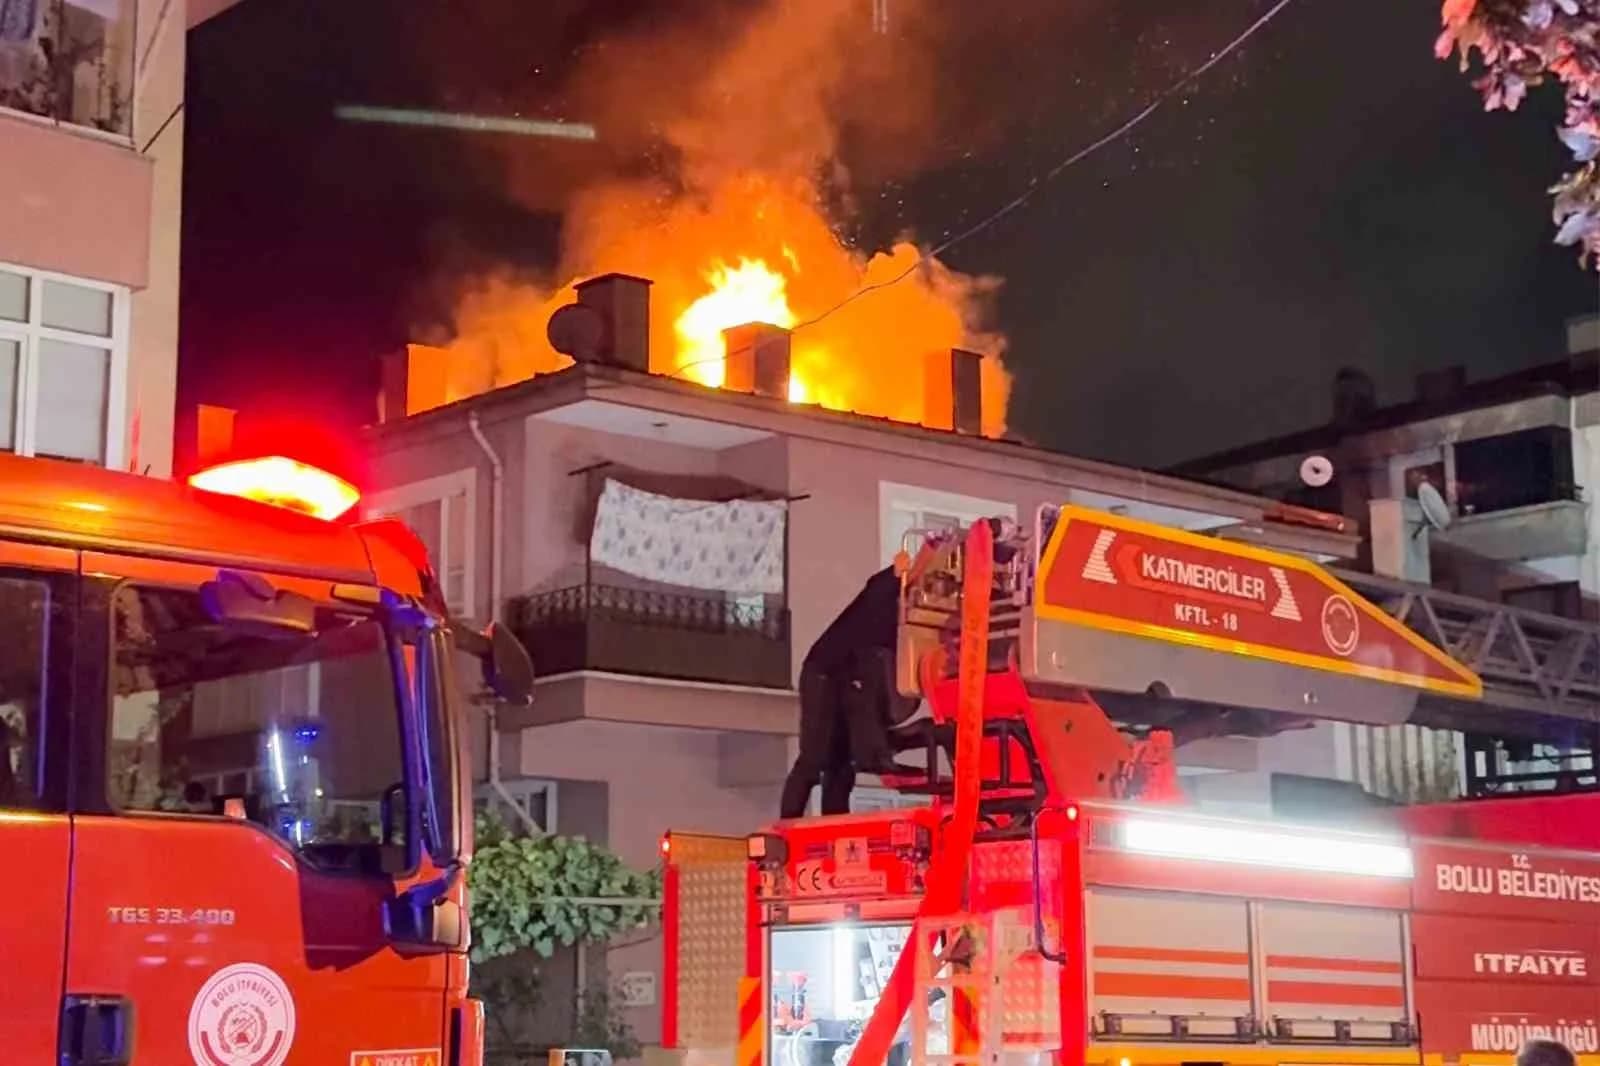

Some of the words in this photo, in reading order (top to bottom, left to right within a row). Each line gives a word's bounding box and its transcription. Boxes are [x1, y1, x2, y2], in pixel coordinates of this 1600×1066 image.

[1141, 553, 1265, 601] KATMERCİLER
[1174, 603, 1211, 626] KFTL
[1221, 612, 1238, 631] 18
[1436, 864, 1494, 894] BOLU
[108, 906, 151, 924] TGS
[156, 908, 236, 926] 33.400
